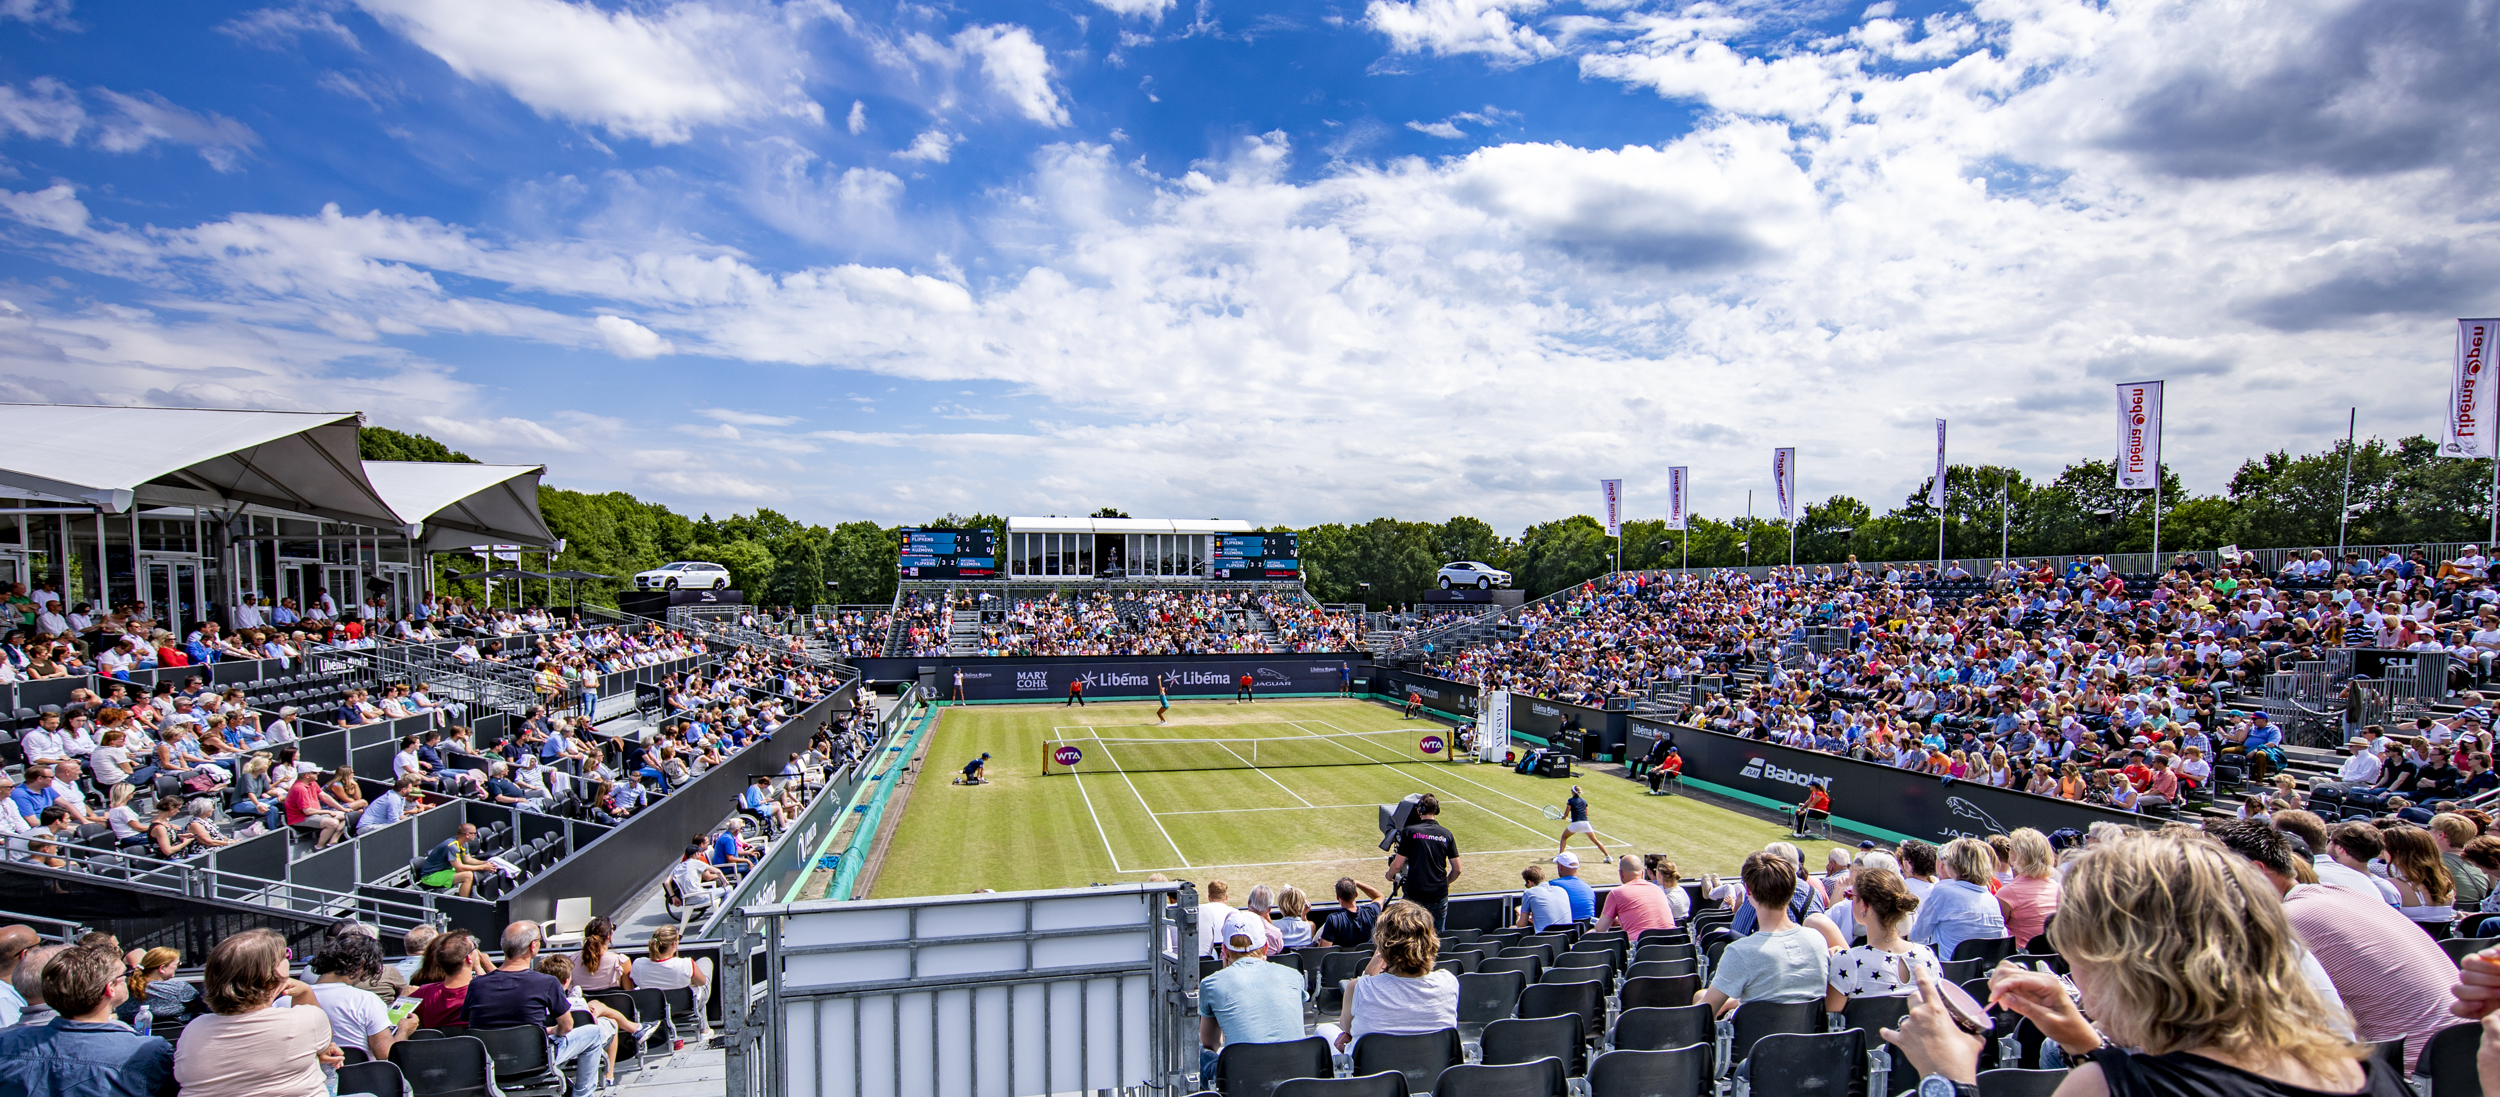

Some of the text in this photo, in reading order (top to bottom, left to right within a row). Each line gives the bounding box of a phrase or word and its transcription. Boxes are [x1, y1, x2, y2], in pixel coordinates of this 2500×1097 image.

[1016, 671, 1048, 680] MARY
[1100, 672, 1149, 687] Libéma
[1183, 671, 1230, 685] Libéma
[1016, 680, 1048, 688] COHR
[1533, 702, 1547, 713] Libéma
[1547, 706, 1559, 716] Open
[1632, 723, 1652, 736] Libéma
[1653, 728, 1670, 740] Oen
[1055, 752, 1080, 760] WTA
[1746, 768, 1759, 776] PLAY
